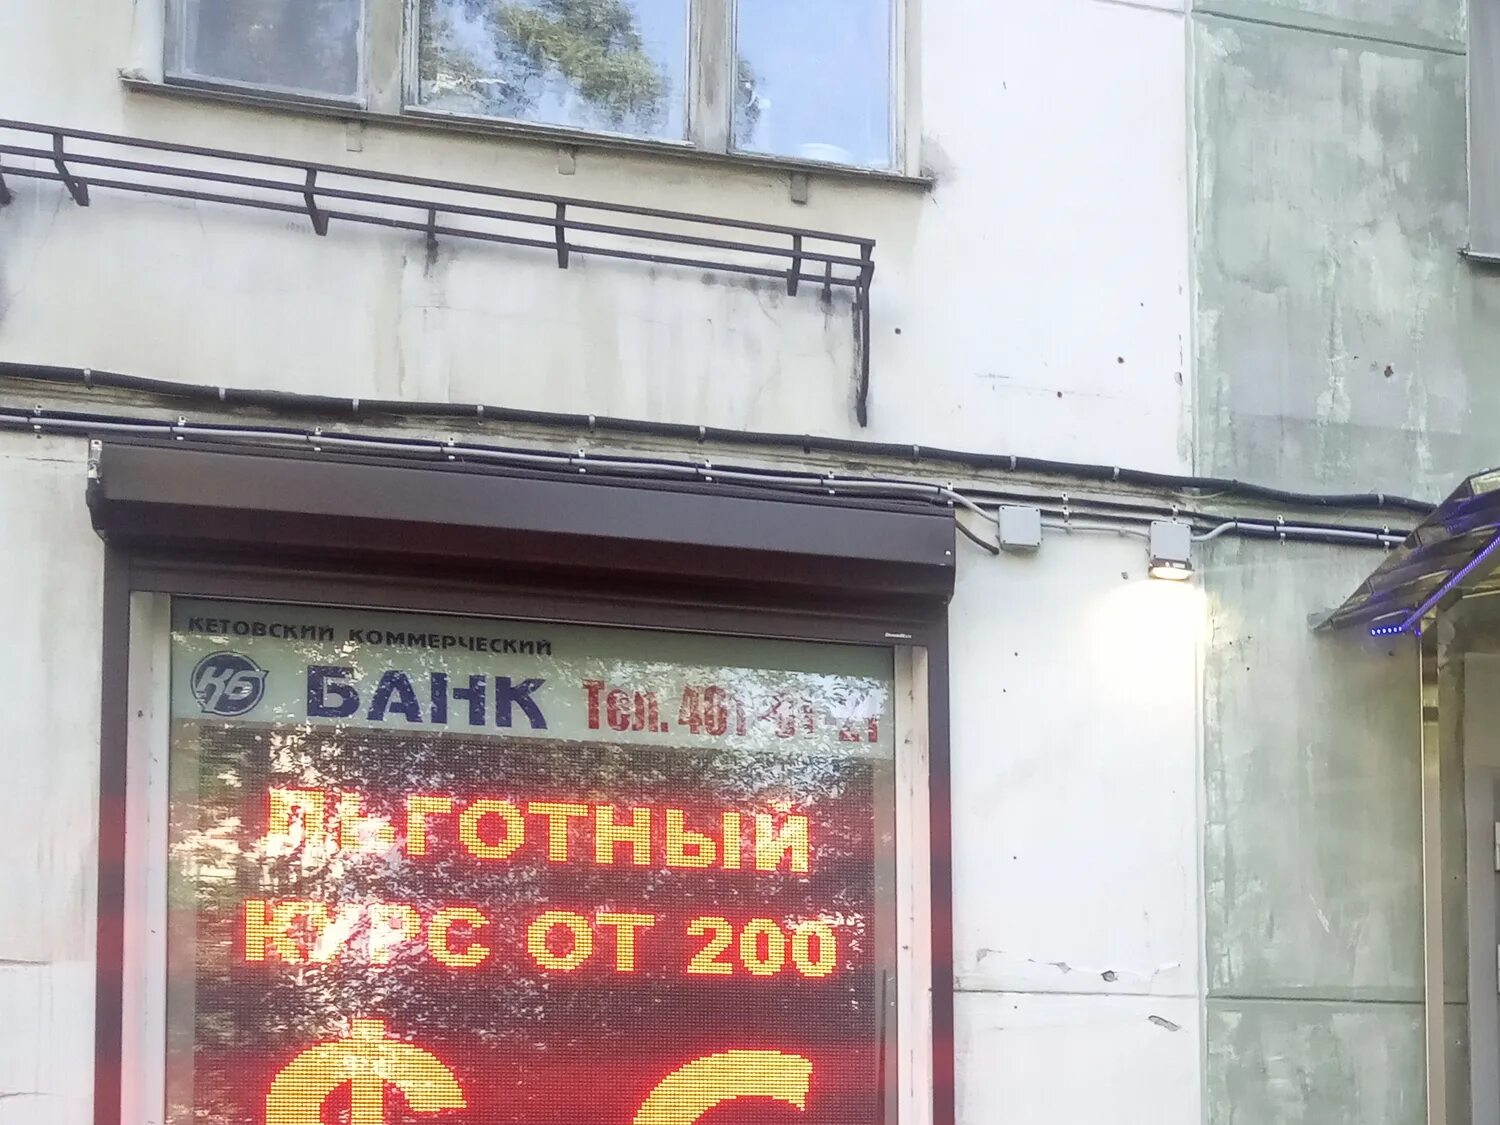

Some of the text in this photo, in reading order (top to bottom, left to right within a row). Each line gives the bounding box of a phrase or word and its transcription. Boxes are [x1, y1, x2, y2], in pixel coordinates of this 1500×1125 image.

[189, 617, 552, 656] КЕТОВСКИЙ КОММЕРЧЕСКИЙ
[307, 665, 548, 730] БАНК
[245, 900, 838, 978] КУРС ОТ 200
